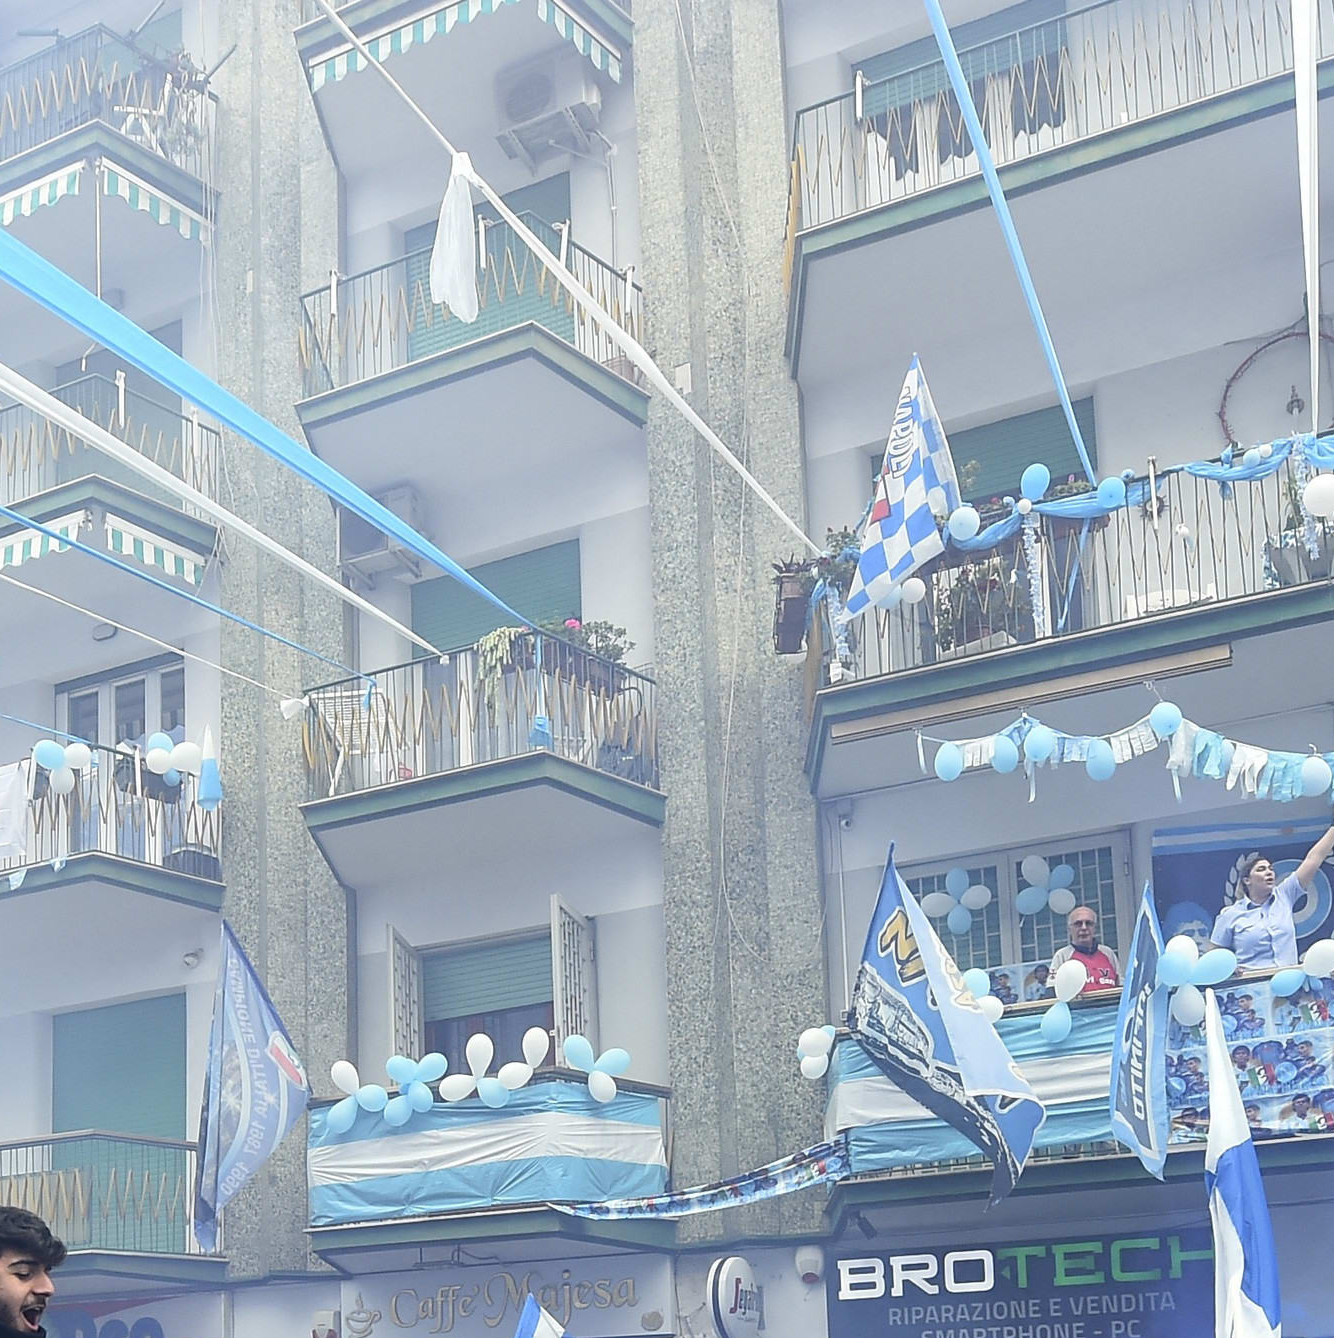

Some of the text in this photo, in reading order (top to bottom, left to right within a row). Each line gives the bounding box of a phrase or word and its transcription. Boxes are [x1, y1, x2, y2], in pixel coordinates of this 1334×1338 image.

[836, 1235, 1214, 1300] BROTECH
[483, 1269, 640, 1328] Majesa
[888, 1291, 1176, 1326] RIPARAZIONE E VENDITA
[1111, 1319, 1142, 1338] PC
